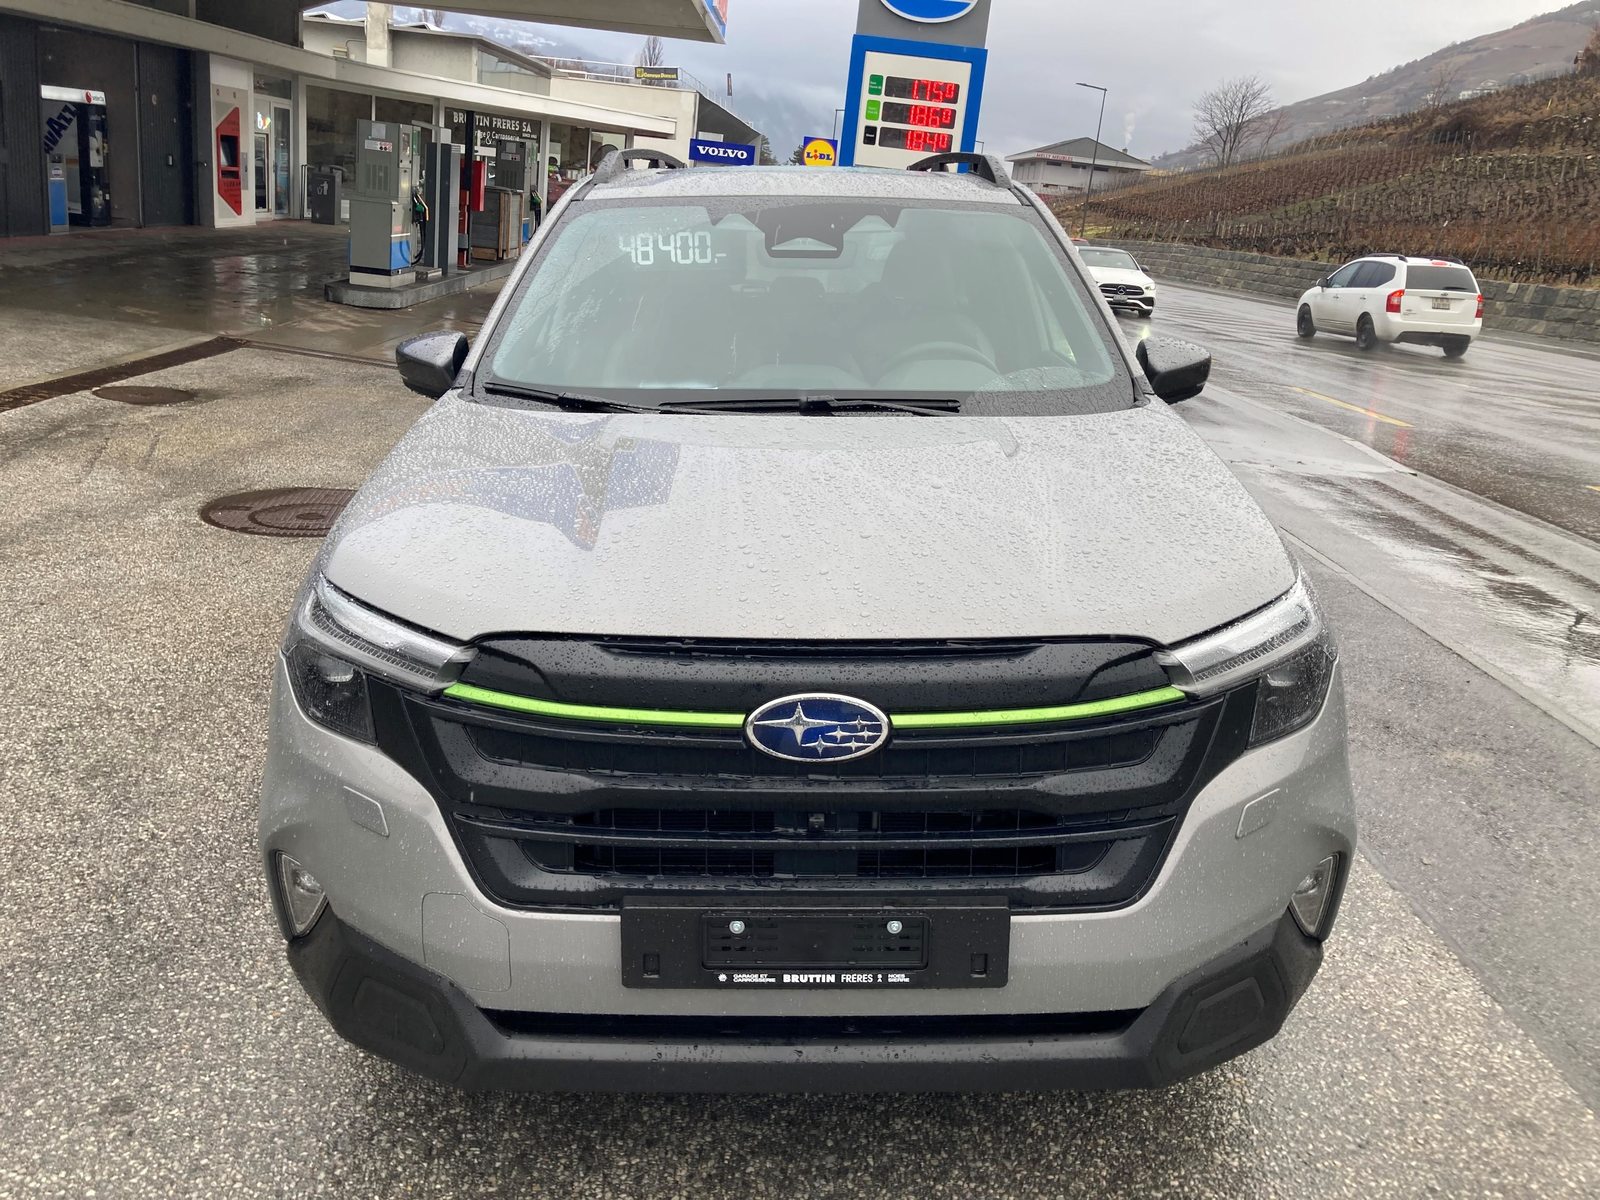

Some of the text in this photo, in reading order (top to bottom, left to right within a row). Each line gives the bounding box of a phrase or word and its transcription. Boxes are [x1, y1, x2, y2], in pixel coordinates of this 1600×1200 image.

[453, 111, 532, 133] BRTIN FRERES SA
[697, 145, 748, 160] VOLVO
[783, 973, 836, 983] BRUTTIN
